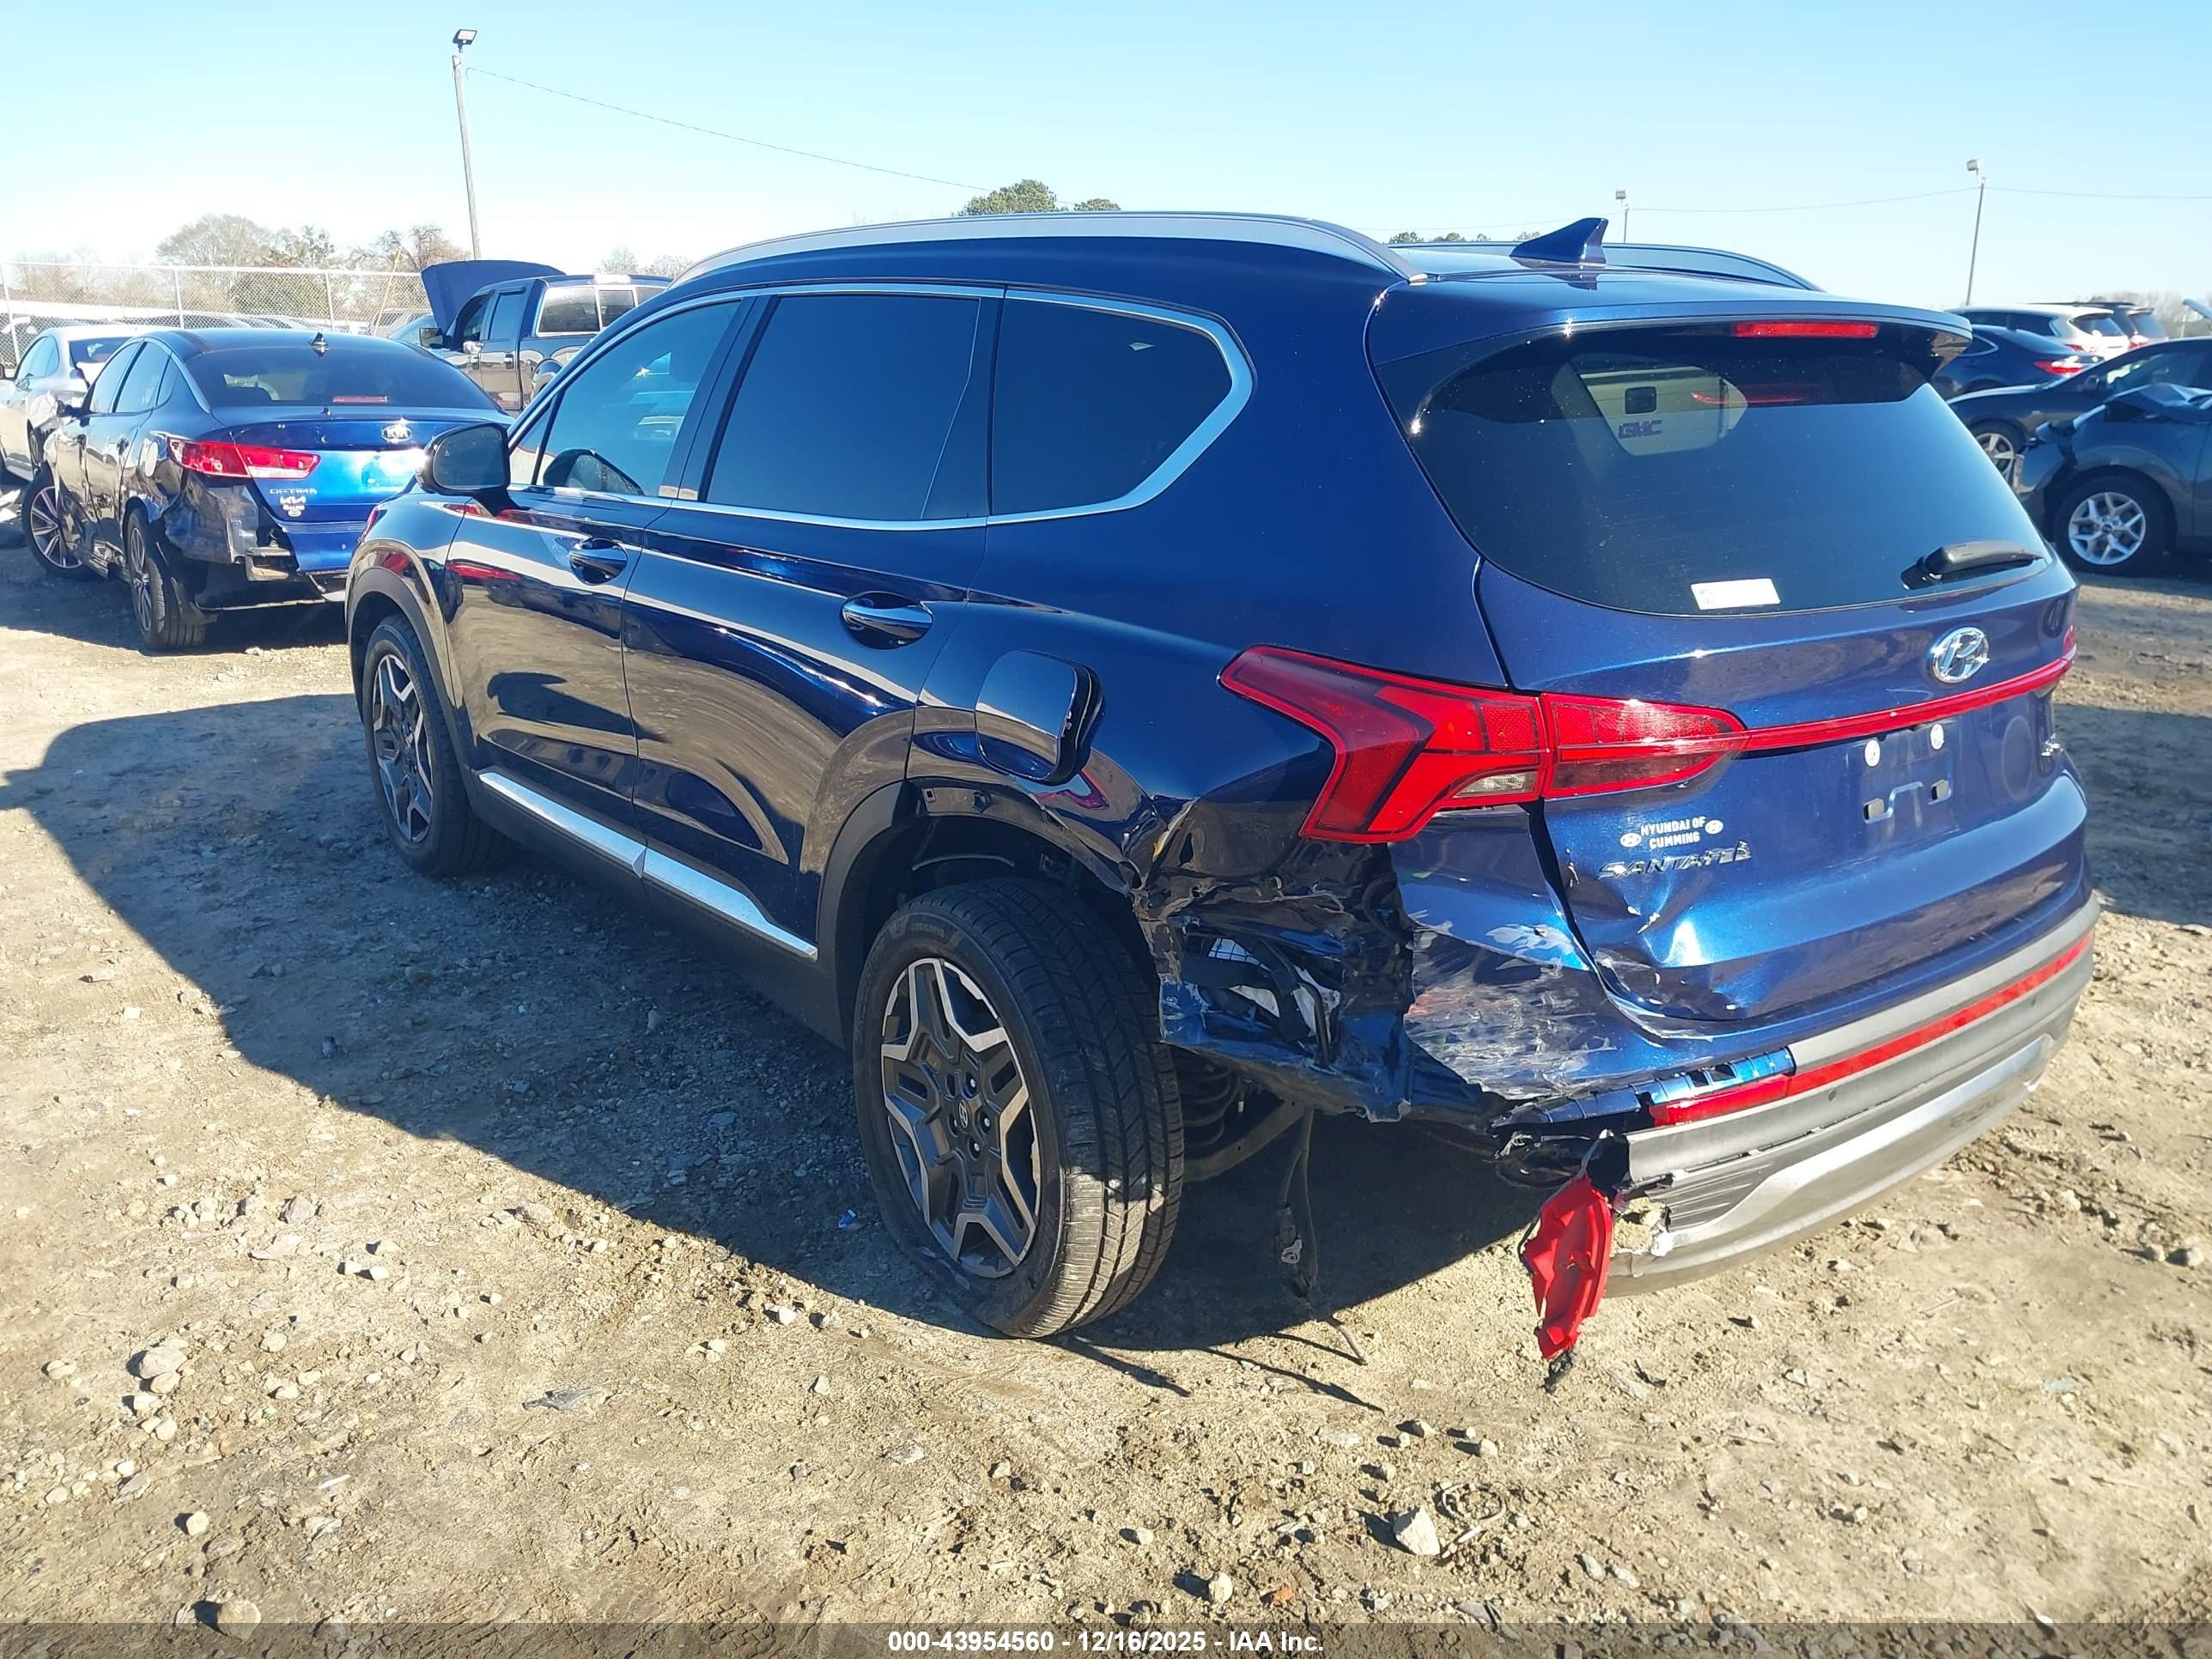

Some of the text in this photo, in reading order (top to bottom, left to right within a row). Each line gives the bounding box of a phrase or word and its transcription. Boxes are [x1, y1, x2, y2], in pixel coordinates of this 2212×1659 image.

[1618, 419, 1662, 440] GMC
[1640, 816, 1707, 837] HYUNDAI OF
[1649, 831, 1701, 850] CUMMING
